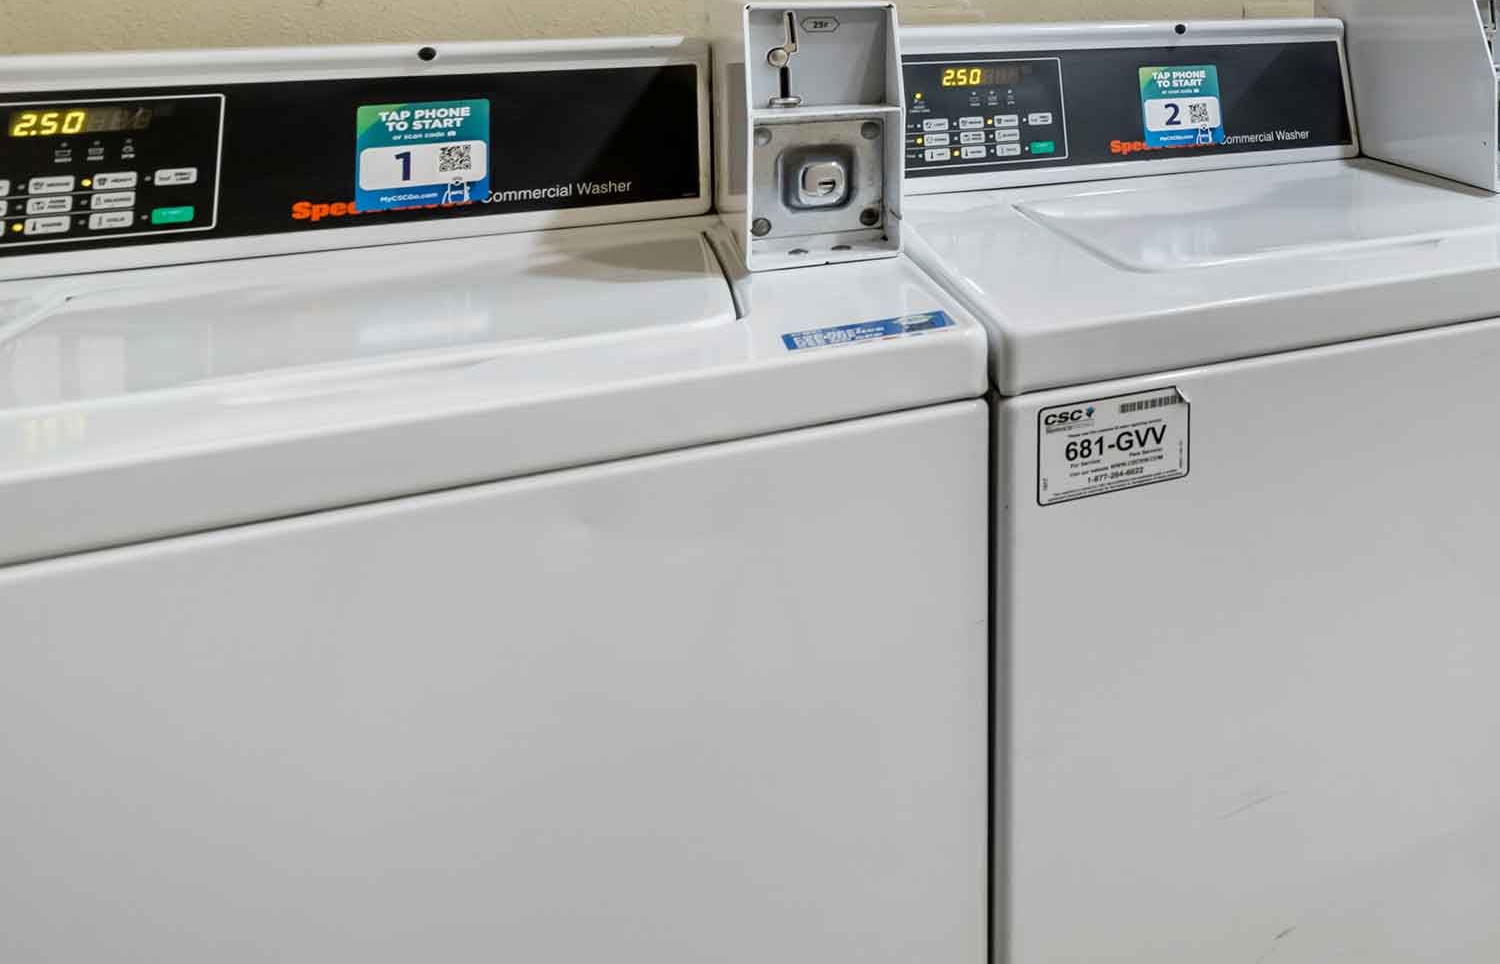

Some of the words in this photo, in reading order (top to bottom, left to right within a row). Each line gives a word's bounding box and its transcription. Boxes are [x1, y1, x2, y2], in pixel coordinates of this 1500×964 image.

[942, 68, 982, 86] 2.50
[1151, 71, 1170, 80] TAP
[1172, 70, 1206, 79] PHONE
[1156, 79, 1170, 88] TO
[1172, 78, 1203, 87] START
[377, 110, 411, 122] TAP
[414, 106, 471, 119] PHONE
[1164, 103, 1181, 126] 2
[13, 111, 86, 136] 2.50
[385, 121, 409, 132] TO
[412, 117, 464, 131] START
[1275, 129, 1310, 141] Washer
[394, 151, 411, 182] 1
[576, 180, 632, 195] Washer
[1044, 409, 1083, 426] CSC
[1065, 424, 1167, 461] 681-GVV
